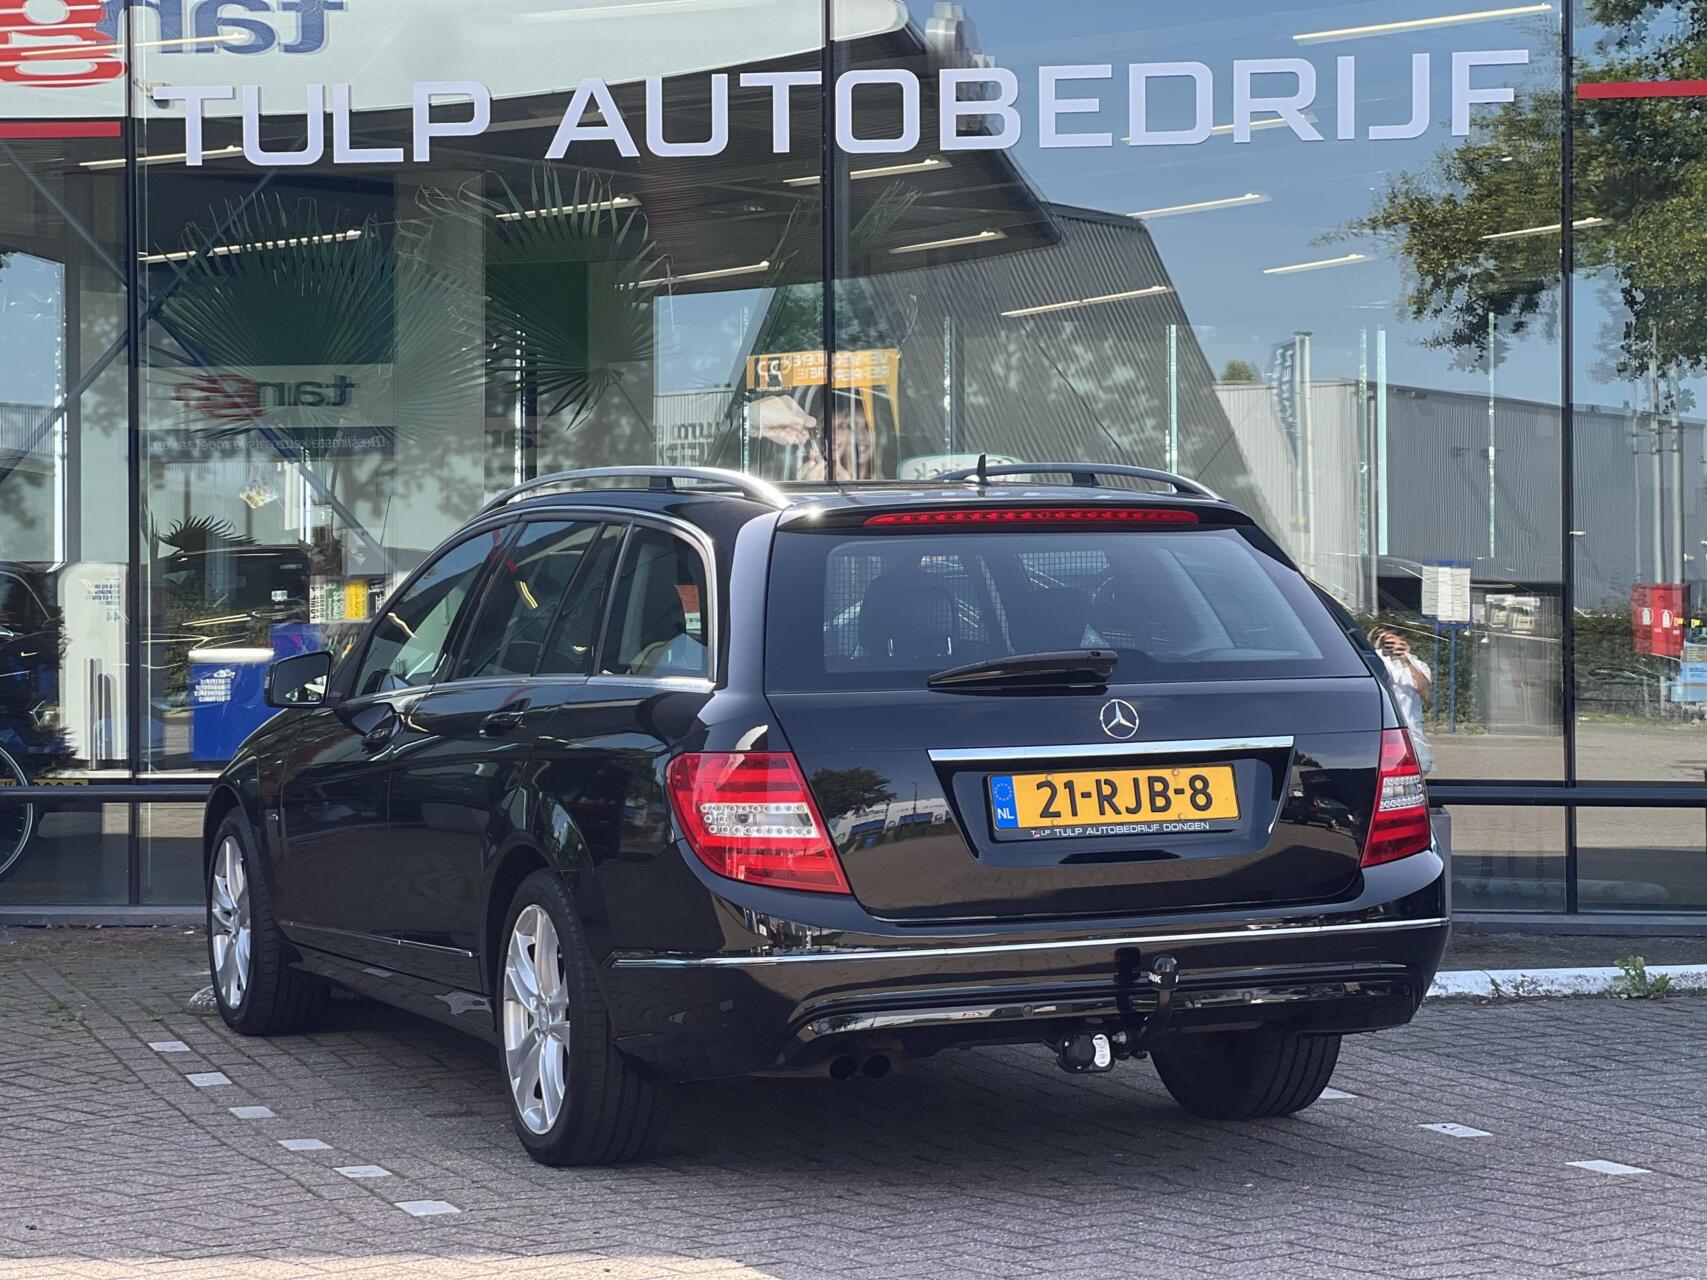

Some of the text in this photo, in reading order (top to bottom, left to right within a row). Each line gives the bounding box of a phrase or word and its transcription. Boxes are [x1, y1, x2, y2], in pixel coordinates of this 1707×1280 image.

[153, 49, 1530, 166] TULP AUTOBEDRIJF
[1036, 774, 1213, 818] 21-RJB-8
[997, 808, 1015, 820] NL
[1054, 827, 1083, 837] TULP
[1085, 823, 1160, 836] AUTOBEDRIJF
[1163, 821, 1210, 832] DONGEN
